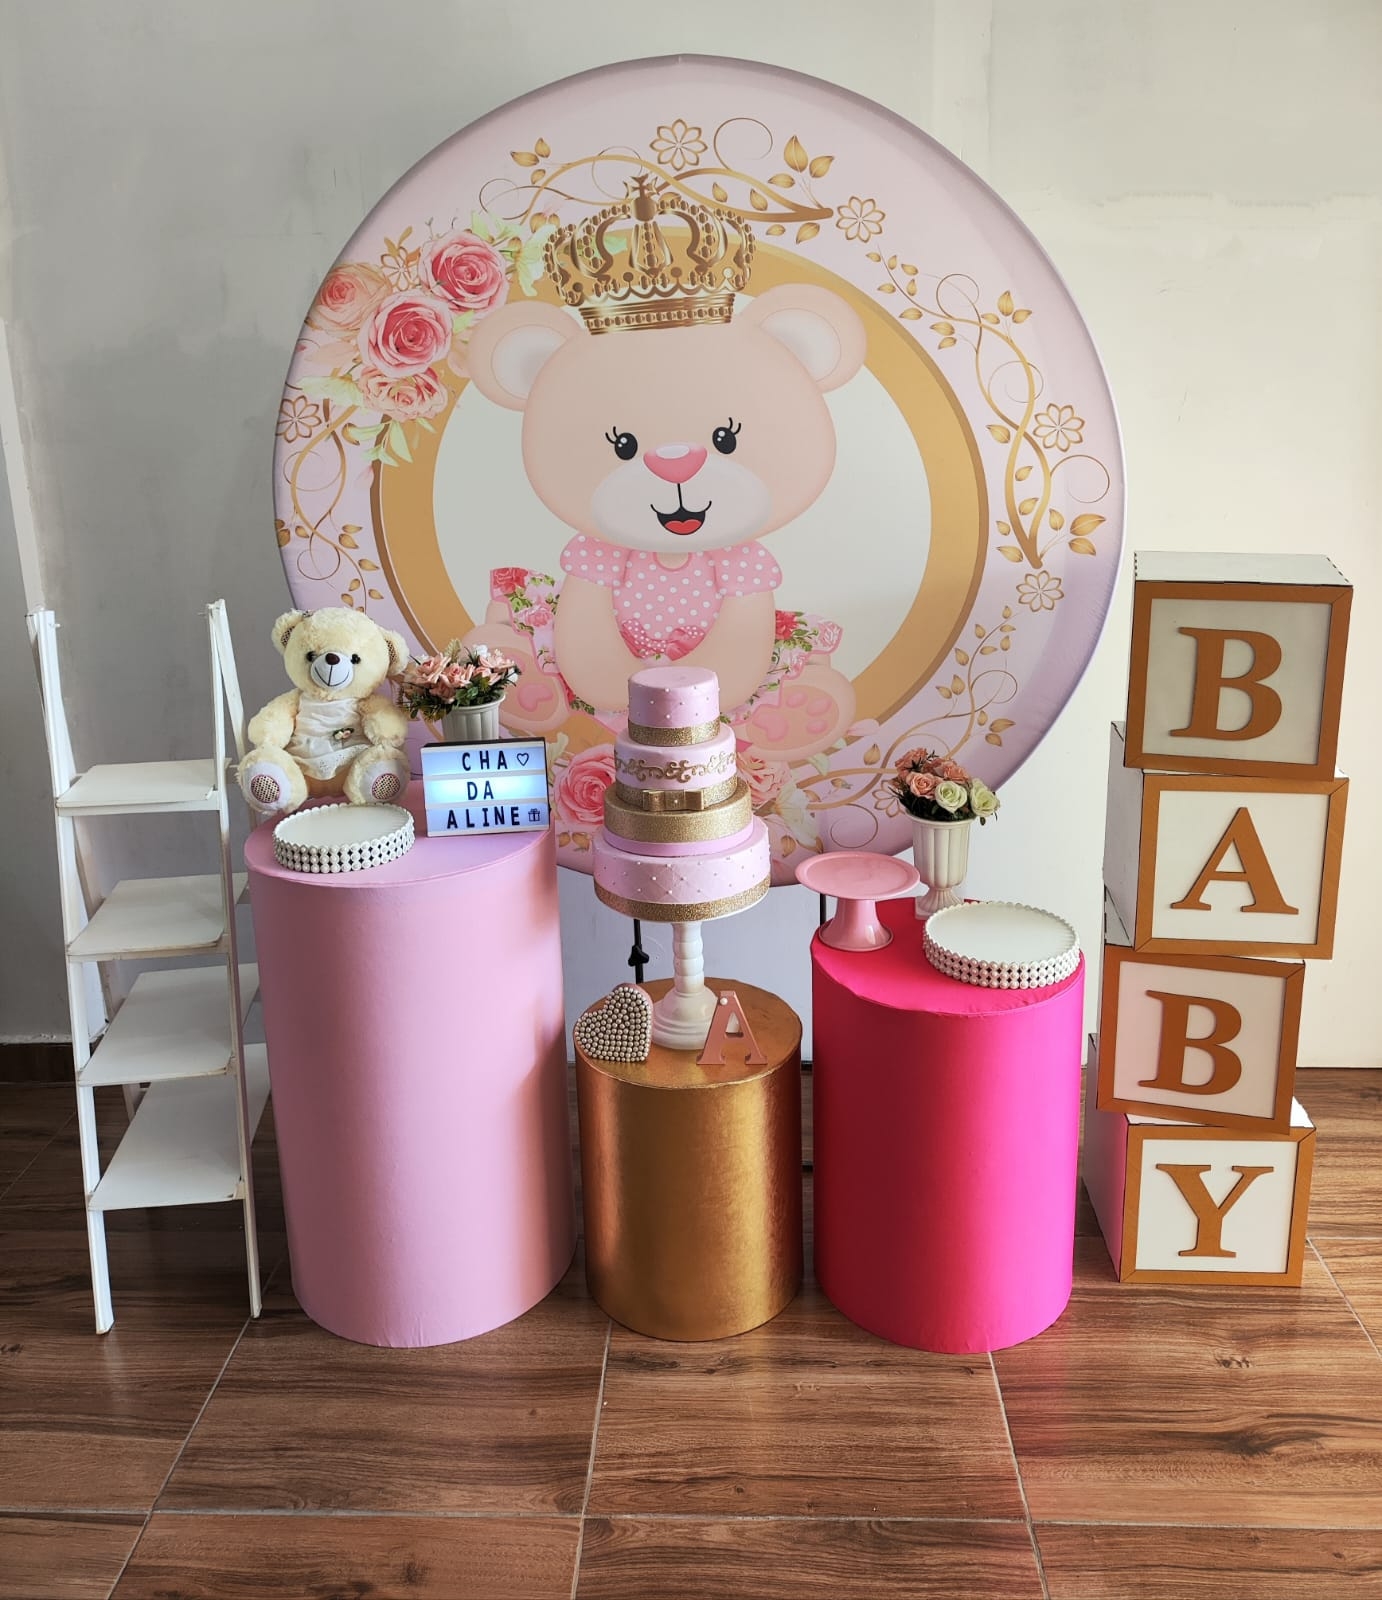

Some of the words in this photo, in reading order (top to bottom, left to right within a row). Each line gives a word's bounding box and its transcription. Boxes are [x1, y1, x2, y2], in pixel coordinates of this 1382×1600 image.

[461, 750, 508, 771] CHA
[466, 780, 494, 801] DA
[446, 805, 521, 829] ALINE
[696, 990, 768, 1065] A
